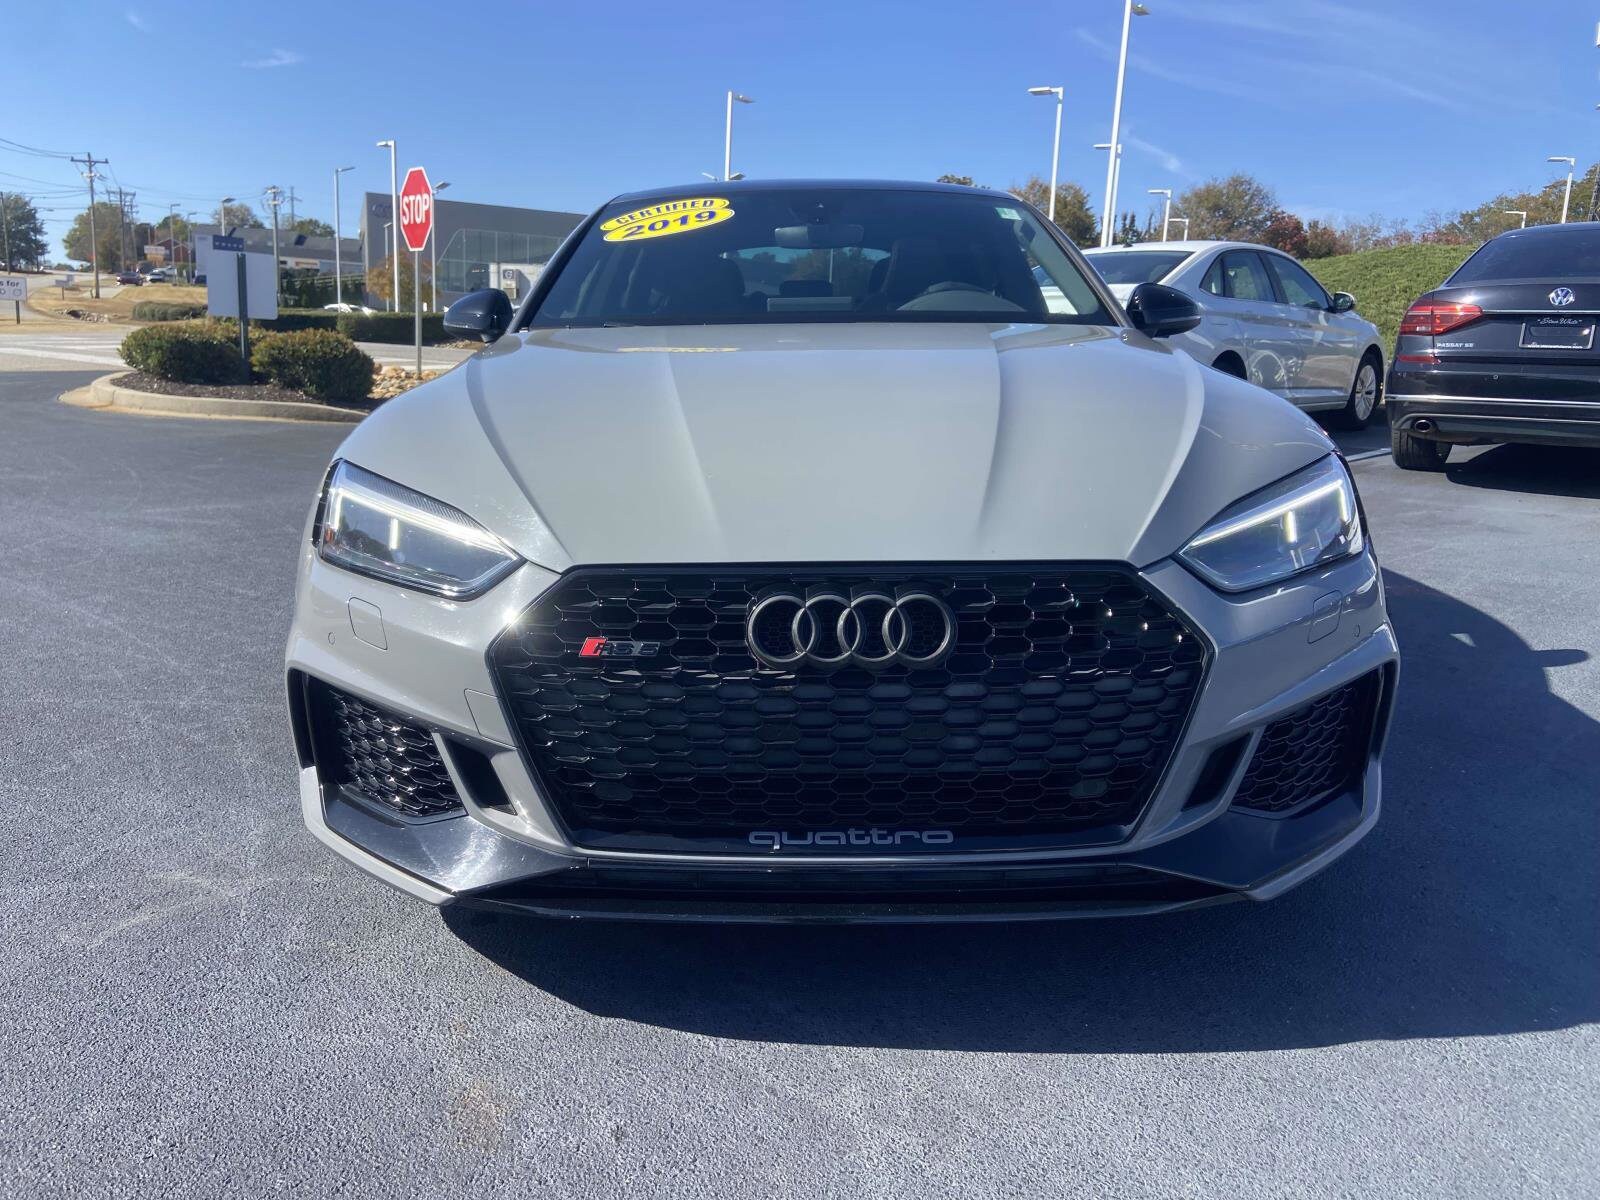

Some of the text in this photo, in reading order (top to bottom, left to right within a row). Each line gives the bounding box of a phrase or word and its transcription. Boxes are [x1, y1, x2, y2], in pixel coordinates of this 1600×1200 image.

[402, 193, 430, 226] STOP
[616, 199, 715, 224] CERTIFIED
[622, 210, 717, 239] 2019
[748, 827, 954, 850] quattro
